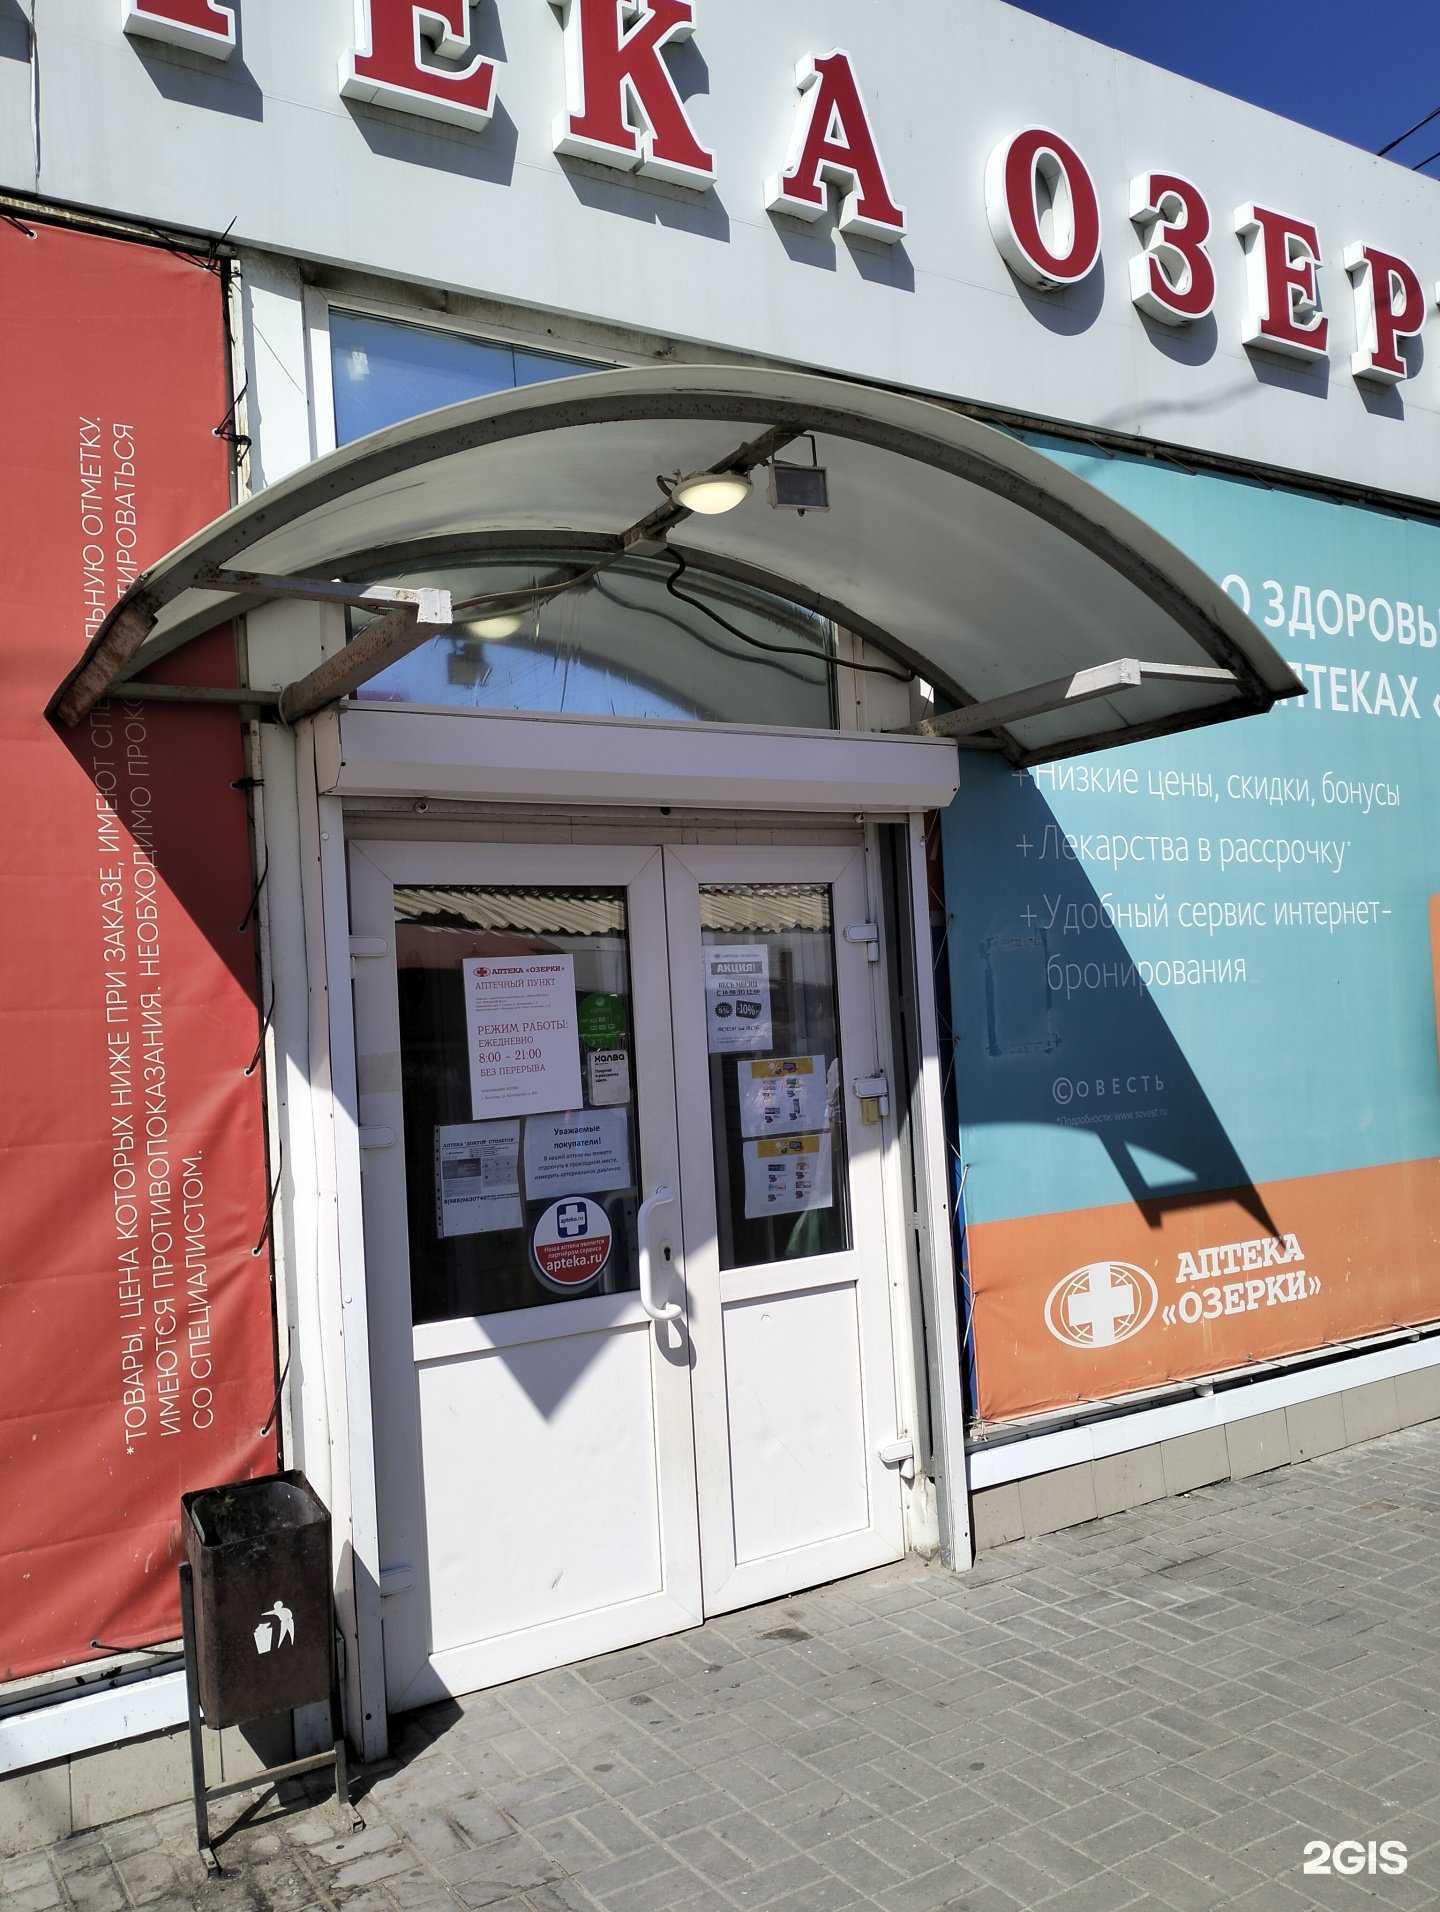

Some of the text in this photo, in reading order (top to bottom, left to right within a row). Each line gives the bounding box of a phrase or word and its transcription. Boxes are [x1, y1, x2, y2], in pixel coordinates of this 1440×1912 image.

[985, 124, 1440, 386] ОЗЕР
[80, 416, 104, 536] ОТМЕТКУ.
[1262, 579, 1440, 648] ЗДОРОВЬ
[93, 756, 121, 852] ИМЕЮТ
[1035, 763, 1138, 794] Низкие
[1148, 769, 1219, 803] цены,
[1227, 775, 1316, 807] скидки,
[1322, 771, 1400, 814] бонусы
[1039, 825, 1189, 870] Лекарства
[1199, 838, 1212, 862] в
[130, 786, 161, 976] НЕОБХОДИМО
[100, 862, 126, 962] ЗАКАЗЕ,
[1043, 893, 1169, 935] Удобный
[1178, 902, 1267, 936] сервис
[1274, 902, 1392, 935] интернет-
[105, 971, 129, 1023] ПРИ
[475, 978, 556, 990] АПТЕЧНЫЙ ПУНКТ
[492, 967, 524, 976] АПТЕКА
[1047, 953, 1247, 1000] бронирования
[478, 1023, 519, 1036] РЕЖИМ
[478, 1036, 534, 1048] ЕЖЕДНЕВНО
[108, 1031, 133, 1107] НИЖЕ
[479, 1052, 501, 1064] 8:00
[515, 1049, 542, 1061] 21:00
[480, 1064, 546, 1077] БЕЗ ПЕРЕРЫВА
[140, 986, 175, 1289] ПРОТИВОПОКАЗАНИЯ.
[553, 1125, 600, 1136] Уважаемые
[553, 1137, 602, 1150] покупатели!
[111, 1114, 139, 1240] КОТОРЫХ
[118, 1247, 145, 1319] ЦЕНА
[546, 1254, 602, 1272] apteka.ru
[1176, 1233, 1305, 1283] АПТЕКА
[182, 1149, 214, 1429] СО СПЕЦИАЛИСТОМ.
[1162, 1270, 1322, 1326] «ОЗЕРКИ»
[154, 1298, 182, 1436] ИМЕЮТСЯ
